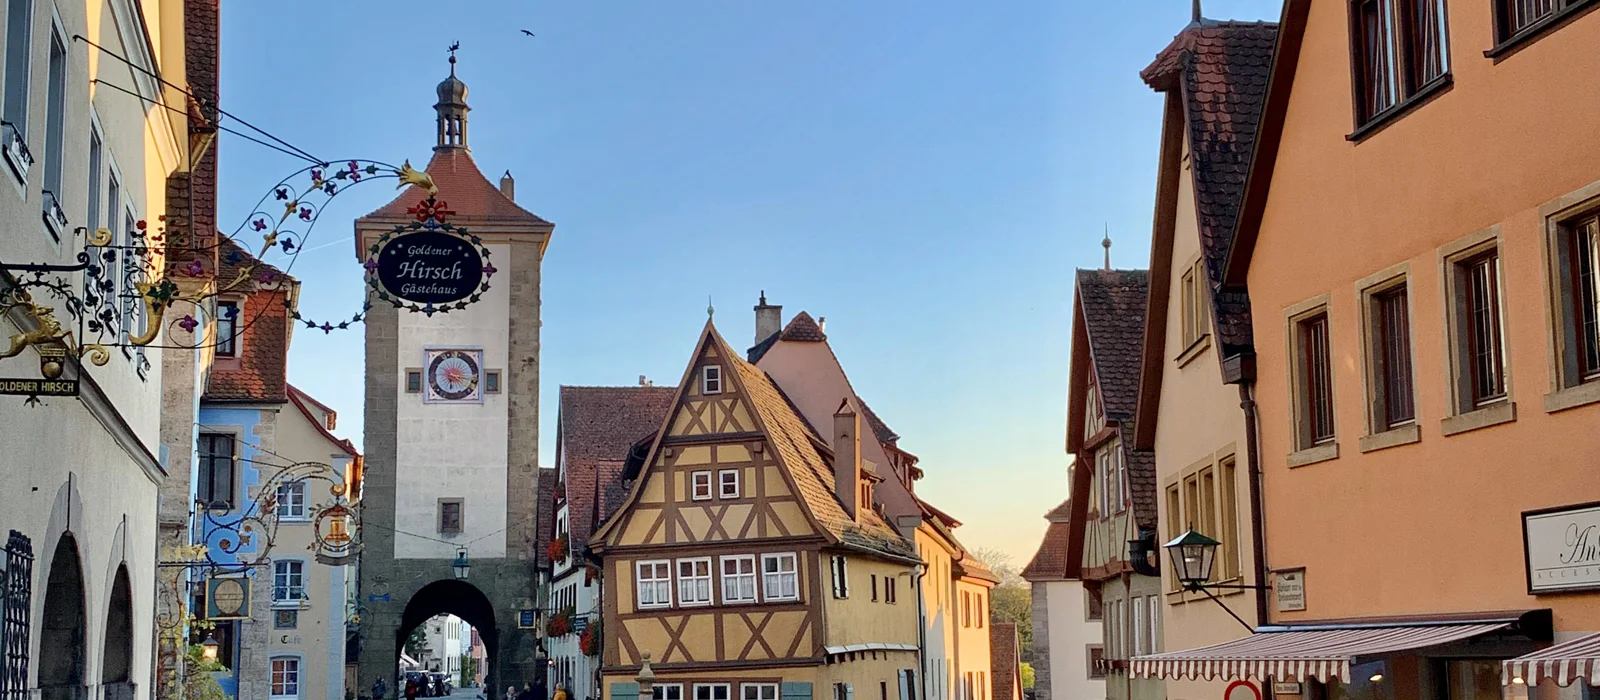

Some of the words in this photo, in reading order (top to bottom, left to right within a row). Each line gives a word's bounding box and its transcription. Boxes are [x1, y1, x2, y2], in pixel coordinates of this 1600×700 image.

[407, 244, 452, 257] Goldener
[396, 260, 463, 280] Hirsch
[401, 283, 458, 296] Gästehaus
[41, 382, 74, 392] HIRSCH
[1560, 522, 1600, 565] An
[1538, 567, 1600, 579] ACCES
